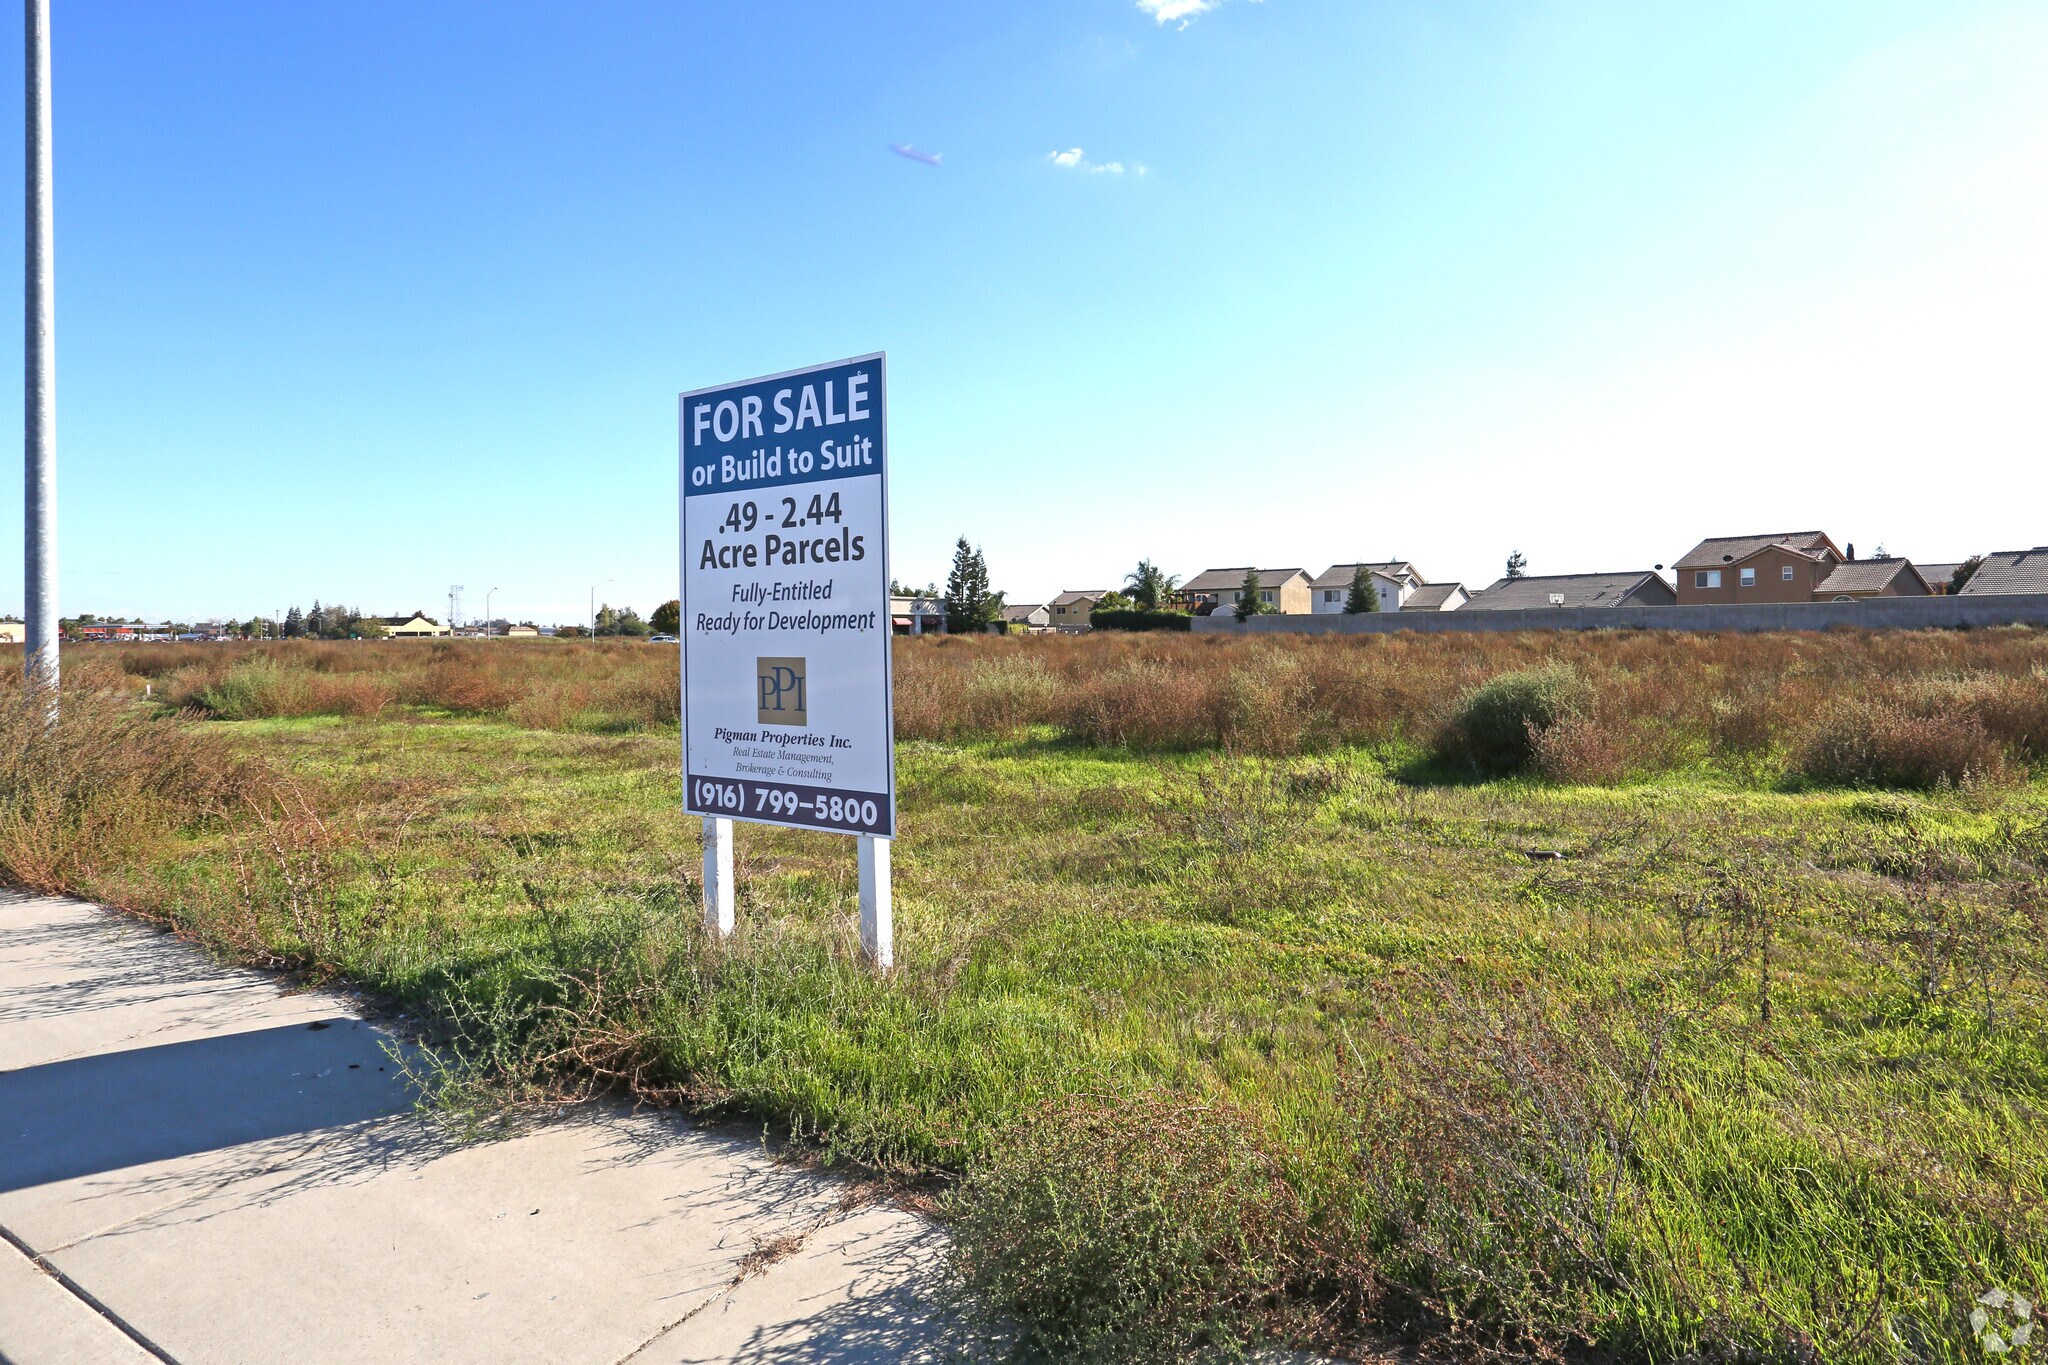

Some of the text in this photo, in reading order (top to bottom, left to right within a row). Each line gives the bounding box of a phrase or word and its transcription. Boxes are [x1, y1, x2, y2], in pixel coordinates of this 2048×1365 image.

[694, 374, 870, 446] FOR SALE
[692, 434, 872, 487] or Build to Suit
[719, 501, 758, 534] .49
[781, 492, 842, 528] 2.44
[700, 527, 864, 570] Acre Parcels
[732, 579, 832, 606] Fully-Entitled
[697, 610, 875, 635] Ready for Development
[714, 728, 852, 748] Pigman Properties Inc.
[733, 747, 834, 765] Real Estate Management,
[736, 763, 832, 782] Brokerage & Consulting
[694, 779, 877, 826] (916) 799-5800
